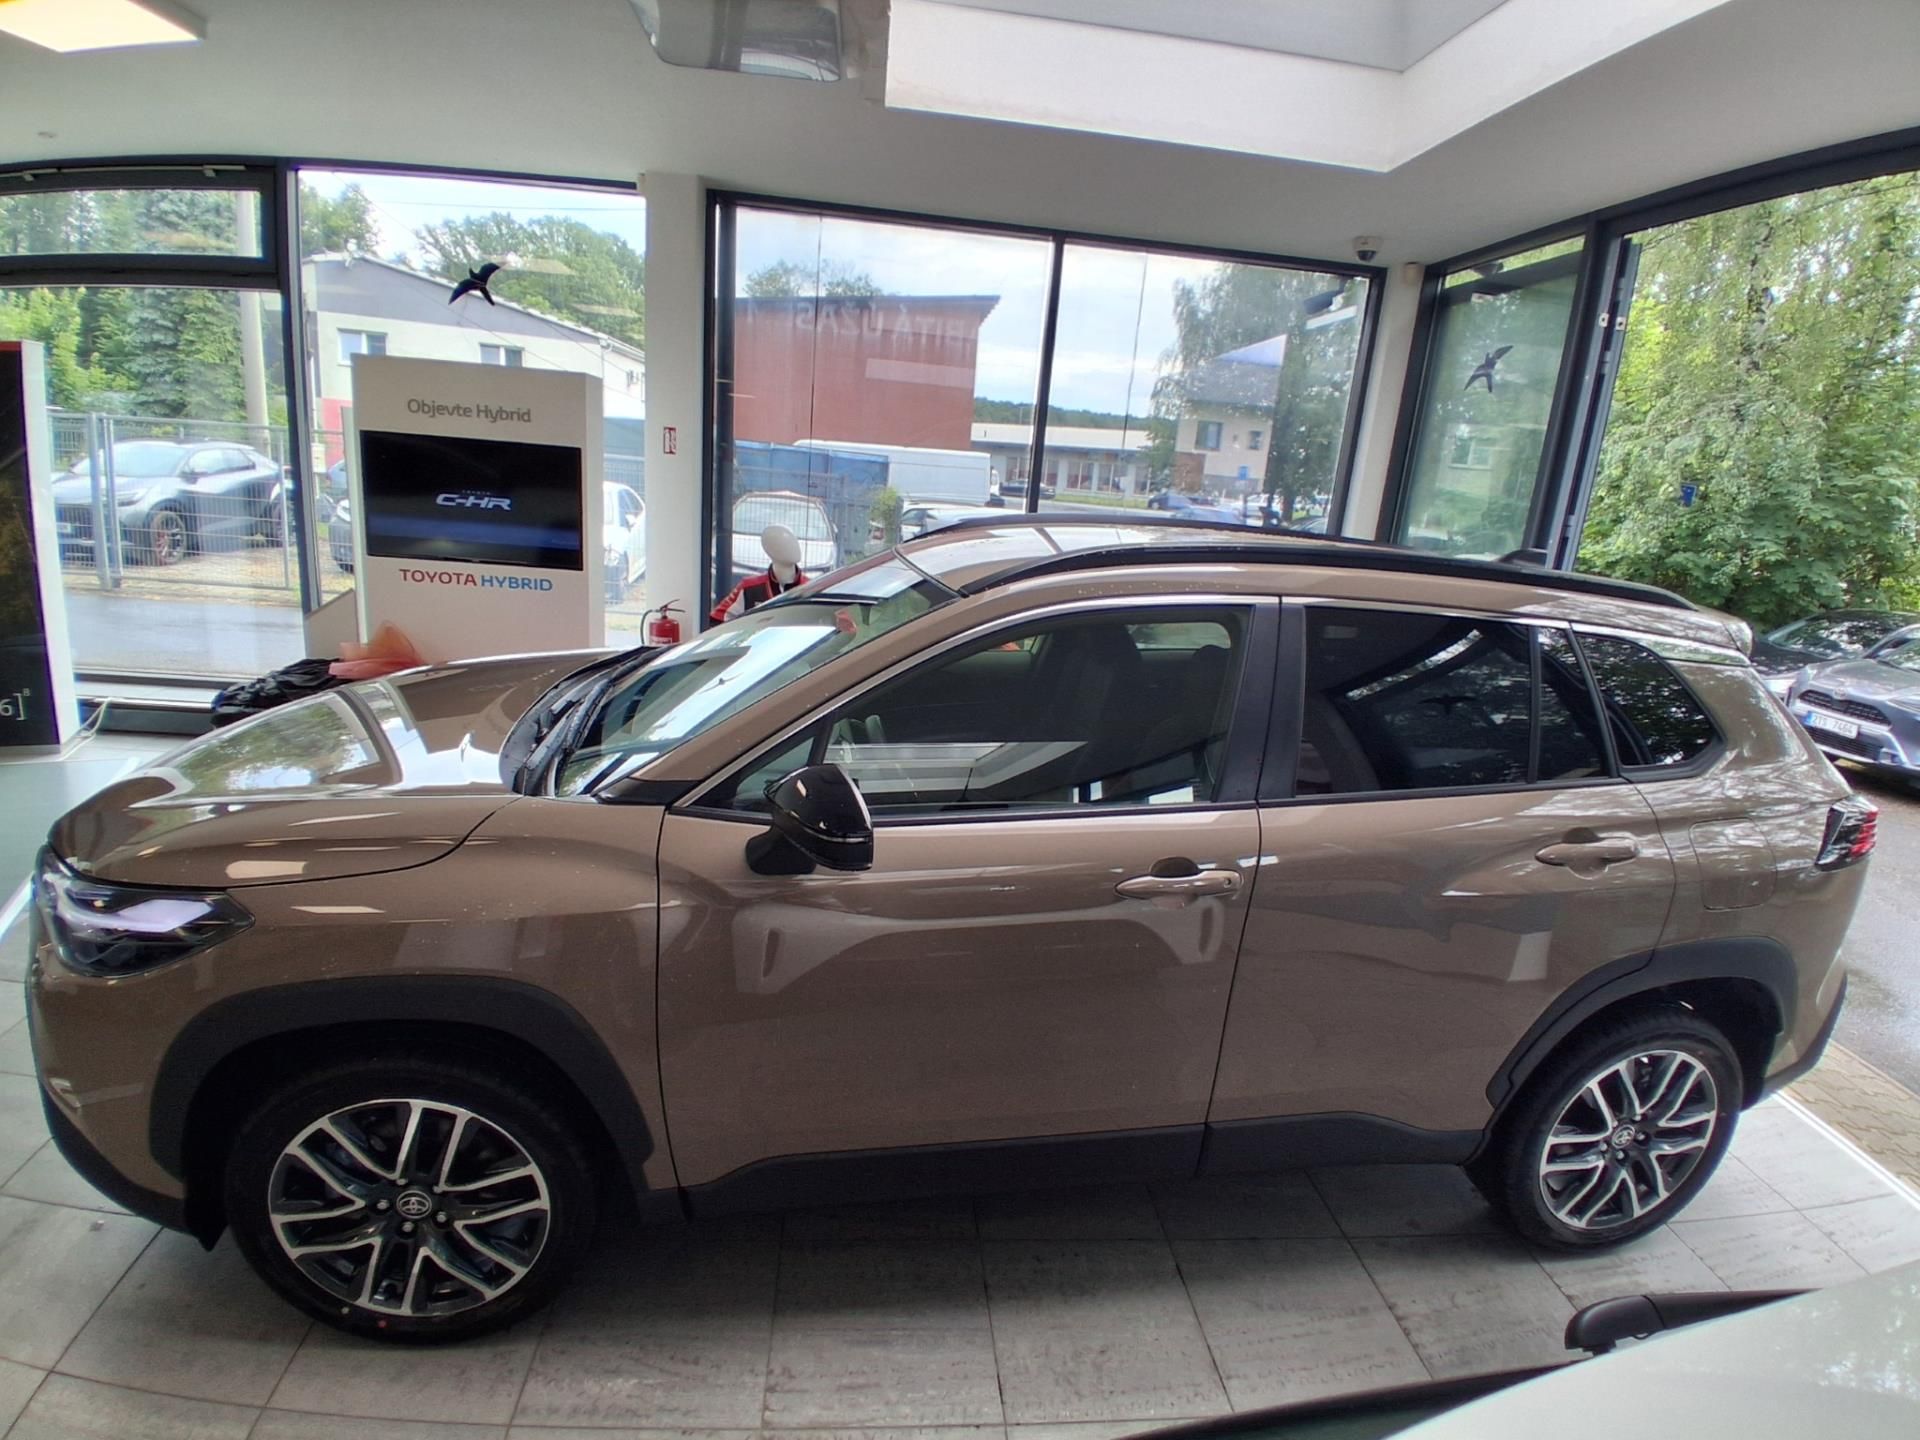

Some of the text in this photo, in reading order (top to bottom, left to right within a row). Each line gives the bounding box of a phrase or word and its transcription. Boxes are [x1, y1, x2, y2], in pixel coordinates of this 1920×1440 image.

[407, 398, 532, 423] Objevte Hybrid
[436, 493, 511, 510] C-HR
[400, 568, 553, 591] TOYOTA HYBRID
